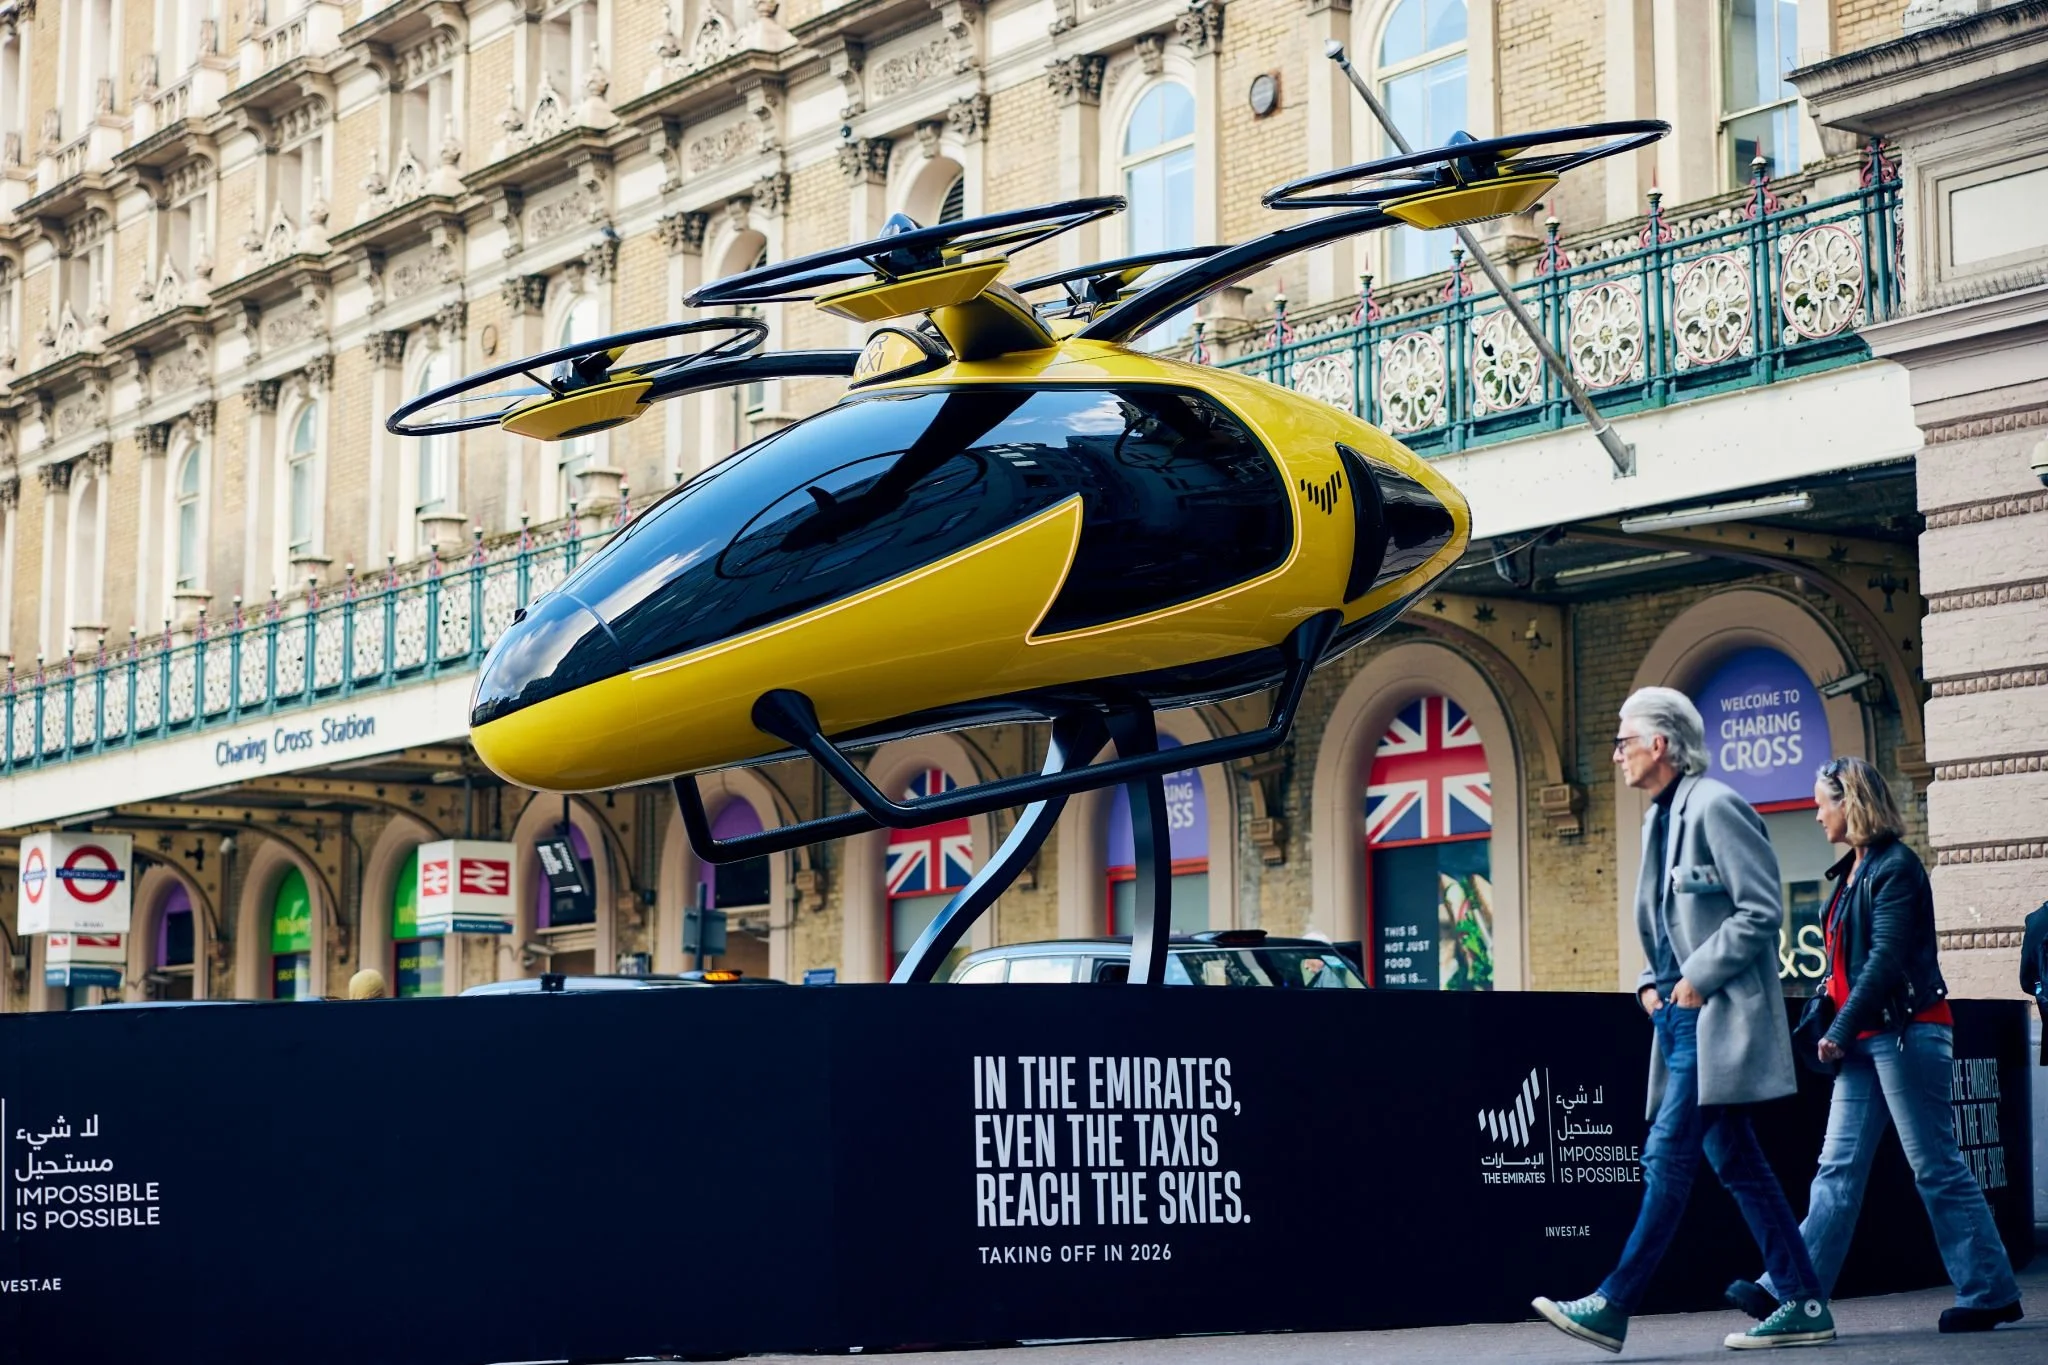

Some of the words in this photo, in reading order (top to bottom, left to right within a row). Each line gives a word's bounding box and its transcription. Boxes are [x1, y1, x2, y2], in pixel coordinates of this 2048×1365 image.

[854, 352, 884, 373] AXI
[1720, 692, 1780, 712] WELCOME
[1783, 689, 1800, 704] TO
[1721, 711, 1801, 740] CHARING
[216, 737, 267, 766] Charing
[274, 728, 313, 754] Cross
[321, 714, 375, 745] Station
[1720, 734, 1803, 772] CROSS
[1384, 926, 1406, 937] THIS
[1408, 925, 1418, 936] IS
[1384, 942, 1404, 953] NOT
[1406, 940, 1430, 952] JUST
[1778, 925, 1827, 979] &S
[1384, 957, 1412, 969] FOOD
[1384, 973, 1407, 984] THIS
[974, 1056, 1006, 1109] IN
[1018, 1056, 1077, 1109] THE
[1088, 1056, 1241, 1116] EMIRATES,
[1592, 1085, 1603, 1104] لا
[1555, 1084, 1588, 1114] شيء
[15, 1116, 71, 1150] شيء
[80, 1114, 99, 1137] لا
[1557, 1115, 1613, 1141] مستحيل
[1963, 1104, 1979, 1145] THE
[1979, 1102, 1999, 1143] TAXIS
[975, 1114, 1055, 1168] EVEN
[1067, 1114, 1124, 1167] THE
[1134, 1113, 1219, 1167] TAXIS
[1559, 1146, 1639, 1162] IMPOSSIBLE
[15, 1152, 114, 1181] مستحيل
[1482, 1173, 1501, 1184] THE
[1502, 1172, 1545, 1184] EMIRATES
[1561, 1168, 1573, 1183] IS
[1577, 1167, 1641, 1183] POSSIBLE
[16, 1182, 160, 1206] IMPOSSIBLE
[976, 1172, 1080, 1227] REACH
[1091, 1172, 1148, 1225] THE
[1159, 1171, 1251, 1225] SKIES.
[16, 1212, 37, 1230] IS
[46, 1207, 160, 1229] POSSIBLE
[1545, 1225, 1590, 1237] INVEST.AE
[979, 1246, 1052, 1264] TAKING
[1060, 1245, 1096, 1262] OFF
[1104, 1244, 1123, 1261] IN
[1131, 1244, 1172, 1261] 2026
[0, 1278, 62, 1293] VEST.AE
